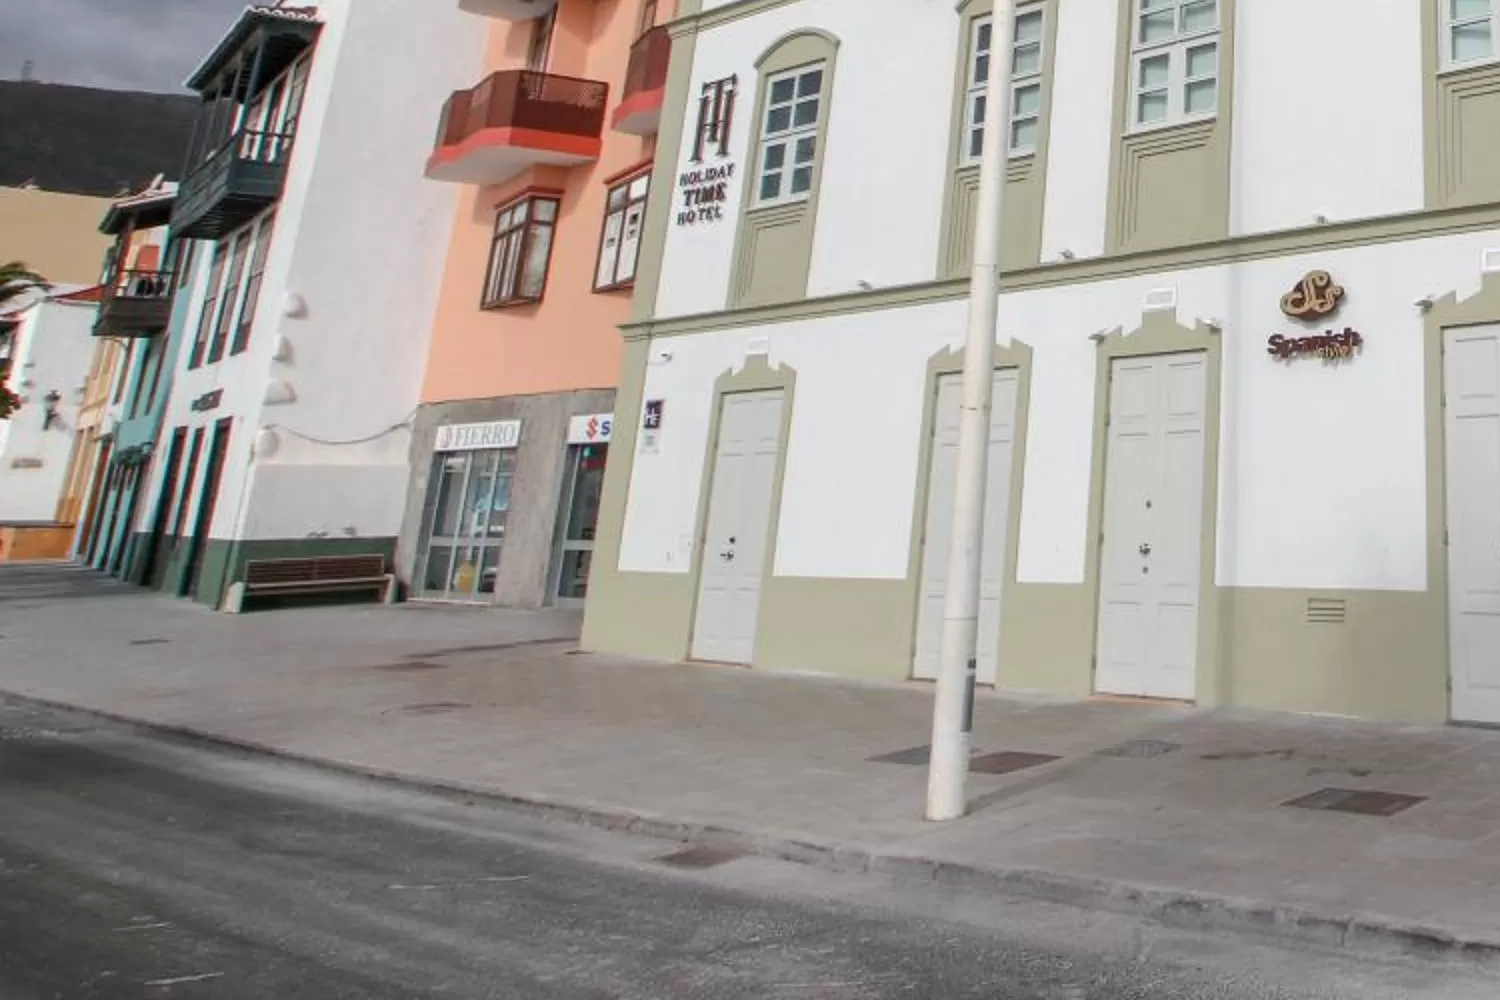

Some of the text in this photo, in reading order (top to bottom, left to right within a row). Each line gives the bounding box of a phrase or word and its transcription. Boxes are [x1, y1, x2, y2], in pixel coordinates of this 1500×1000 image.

[679, 163, 735, 187] HOLIDAY
[684, 182, 727, 207] TIME
[677, 205, 723, 226] HOTEL
[1267, 327, 1363, 358] Spanish
[453, 424, 516, 447] FIERRO
